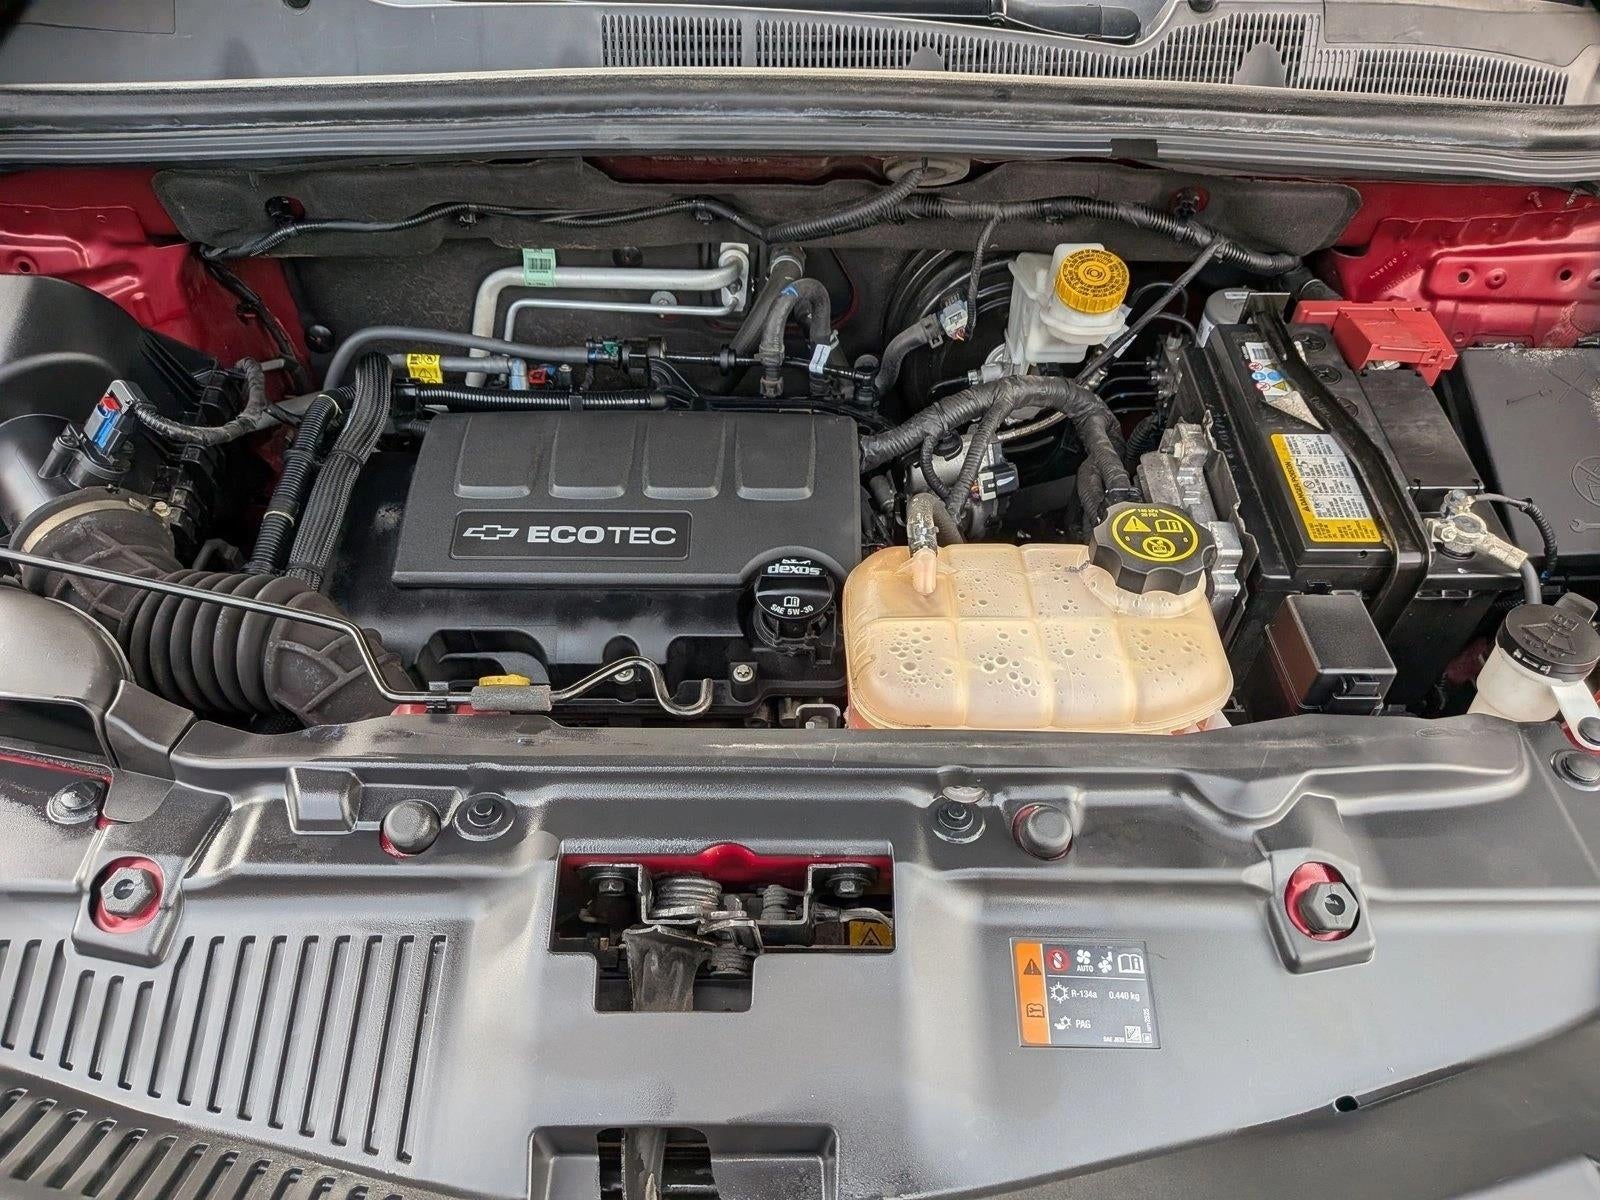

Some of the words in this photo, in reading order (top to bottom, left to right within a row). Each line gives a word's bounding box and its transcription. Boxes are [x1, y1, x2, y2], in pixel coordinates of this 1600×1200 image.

[527, 526, 677, 545] ECOTEC
[767, 563, 821, 575] dexos
[770, 604, 785, 615] SAE
[787, 604, 814, 615] 5W-30
[1076, 965, 1094, 973] AUTO
[1071, 989, 1098, 999] R-134a
[1108, 991, 1129, 1000] 0.440
[1130, 992, 1140, 1002] kg
[1075, 1019, 1092, 1029] PAG
